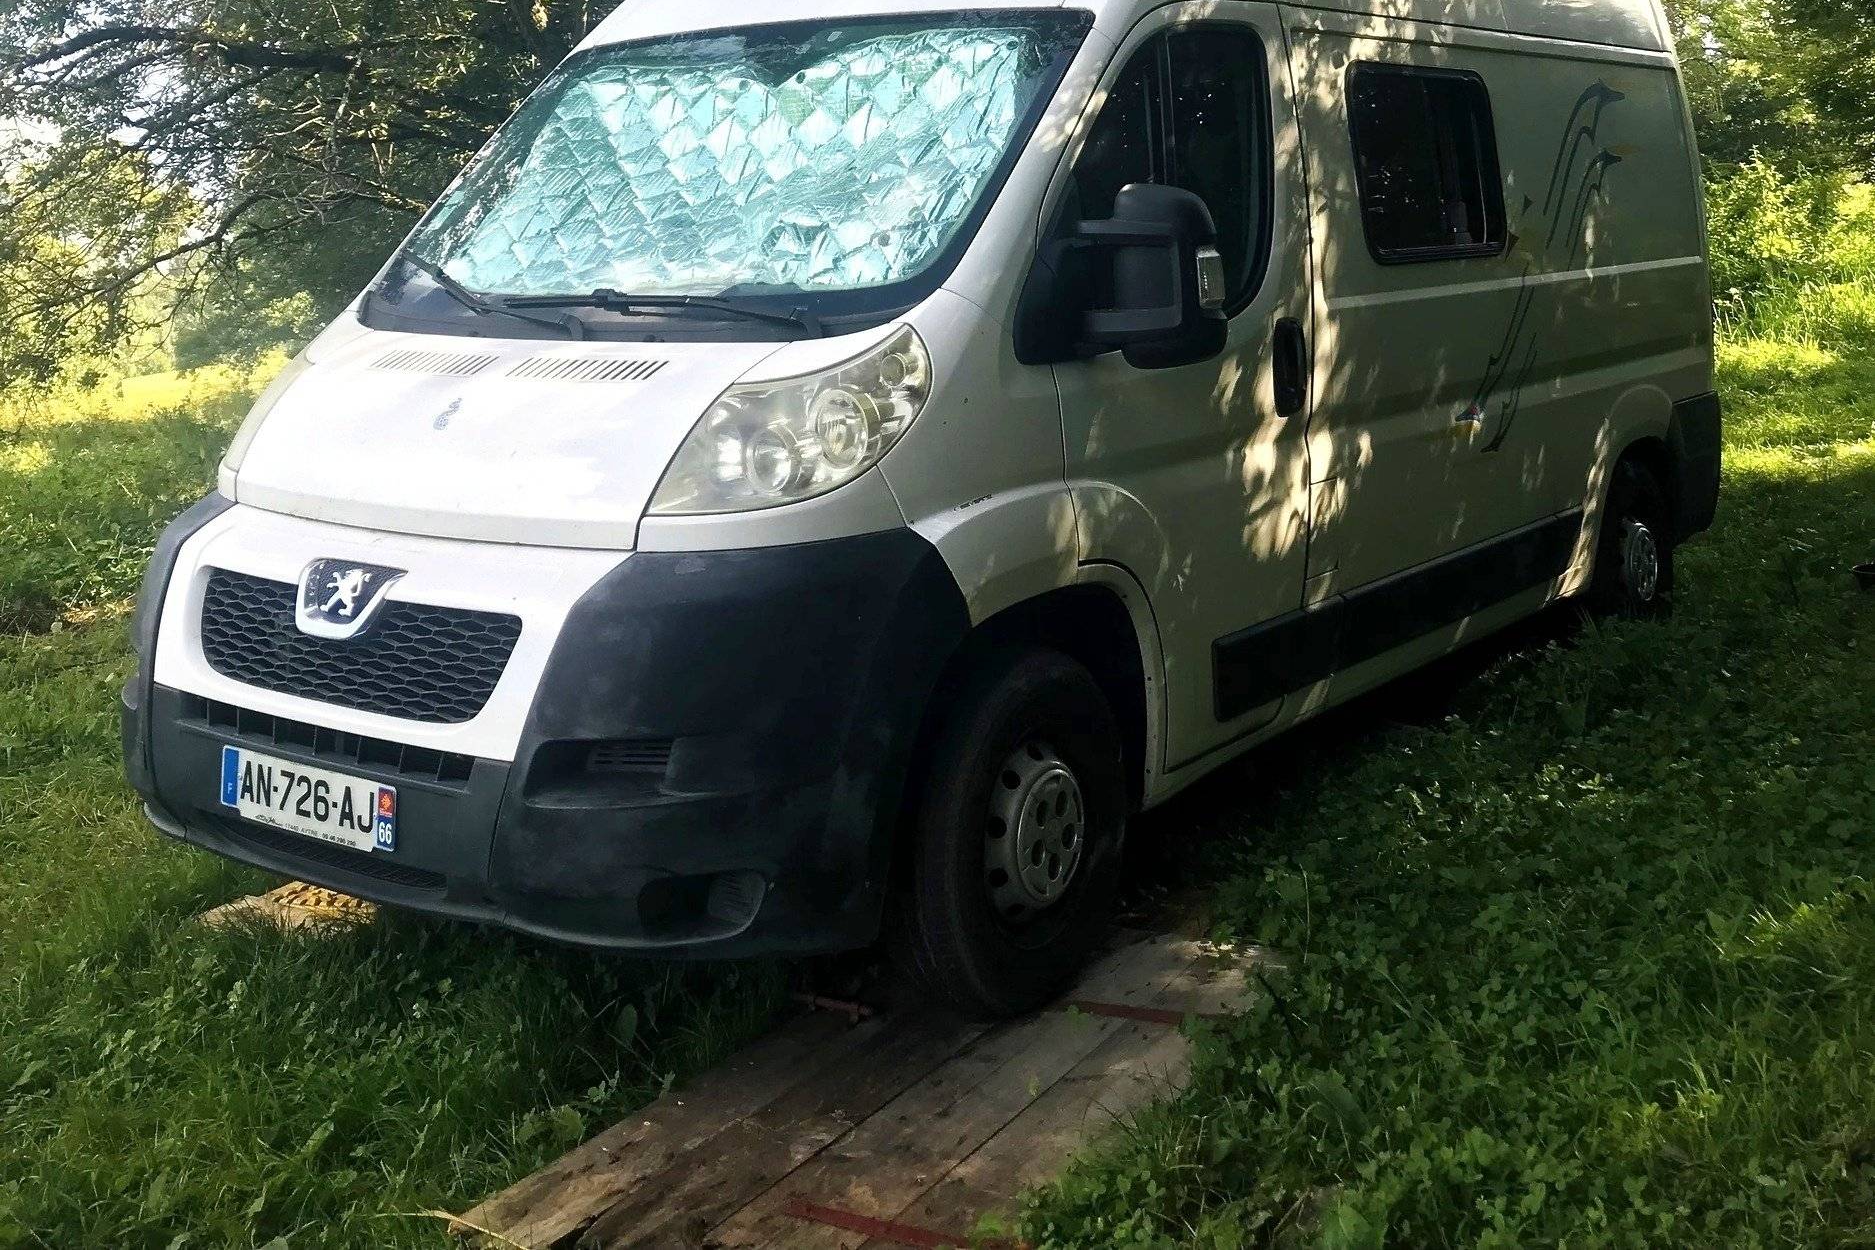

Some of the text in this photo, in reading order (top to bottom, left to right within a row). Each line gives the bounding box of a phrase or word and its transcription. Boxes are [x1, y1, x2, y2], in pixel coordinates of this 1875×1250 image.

[227, 782, 233, 794] F
[240, 760, 375, 834] AN-726-AJ
[378, 821, 392, 845] 66
